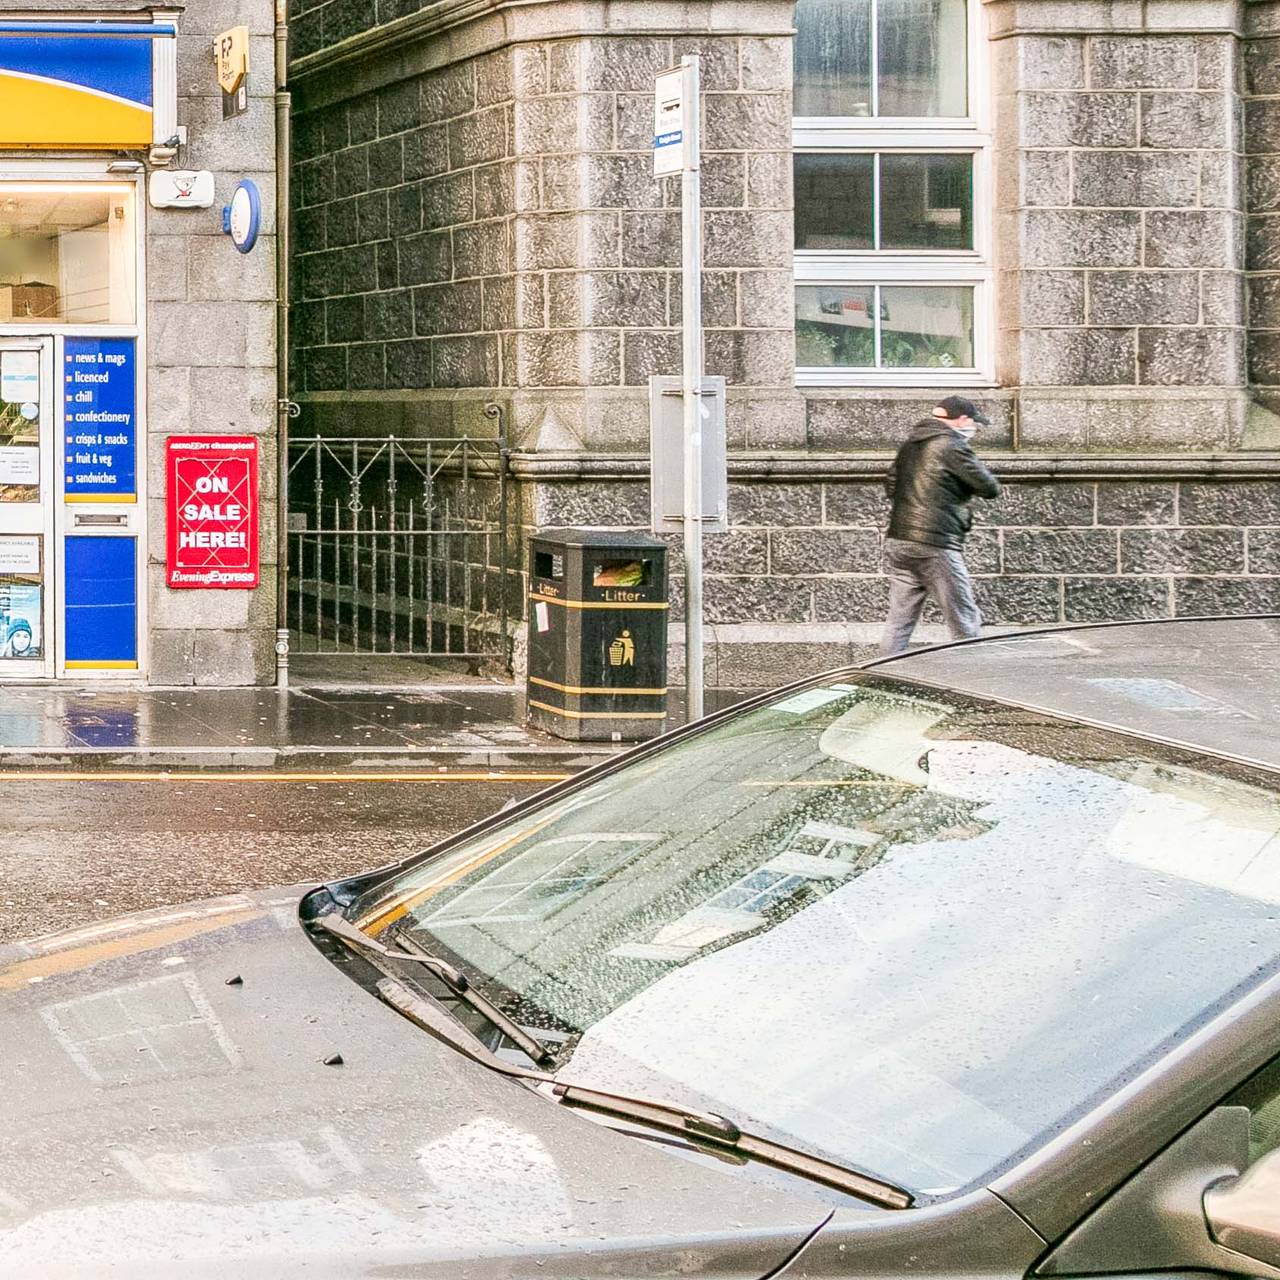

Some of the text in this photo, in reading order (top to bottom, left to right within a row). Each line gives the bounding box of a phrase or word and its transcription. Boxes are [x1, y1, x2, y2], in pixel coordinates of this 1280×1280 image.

[75, 352, 126, 366] news & mags
[75, 372, 109, 383] licenced
[75, 391, 93, 402] chill
[75, 411, 130, 425] confectionery
[75, 433, 97, 446] crisps
[104, 433, 128, 445] snacks
[75, 452, 112, 467] fruit & veg
[75, 472, 117, 484] sandwiches
[196, 477, 229, 494] ON
[184, 505, 241, 521] SALE
[180, 532, 246, 548] HERE!
[539, 583, 557, 597] Litter
[605, 590, 640, 602] Litter
